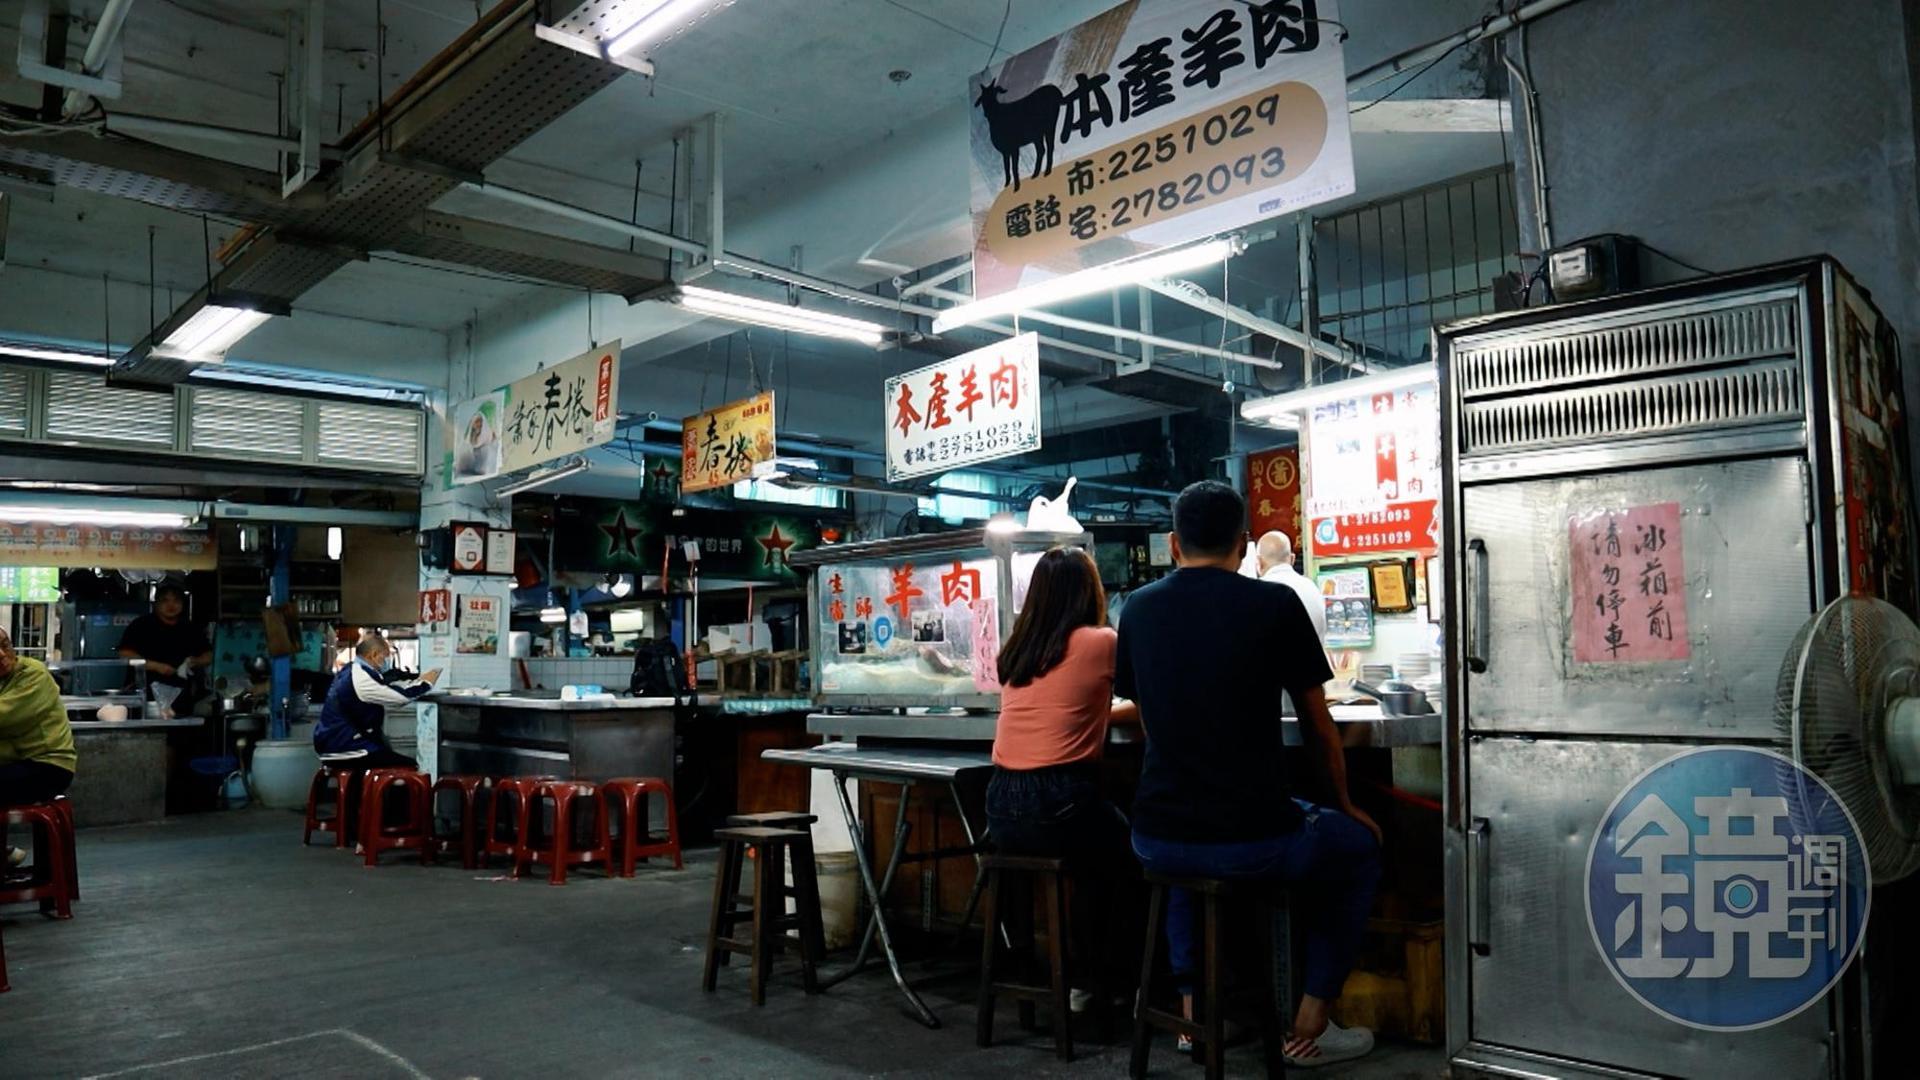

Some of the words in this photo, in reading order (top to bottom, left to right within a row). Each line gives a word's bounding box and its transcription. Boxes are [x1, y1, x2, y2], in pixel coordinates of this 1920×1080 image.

[1060, 0, 1319, 144] 本產羊肉
[1005, 194, 1062, 238] 電話
[893, 356, 1018, 438] 本產羊肉
[885, 560, 981, 618] 羊肉
[1635, 524, 1673, 641] 冰箱前
